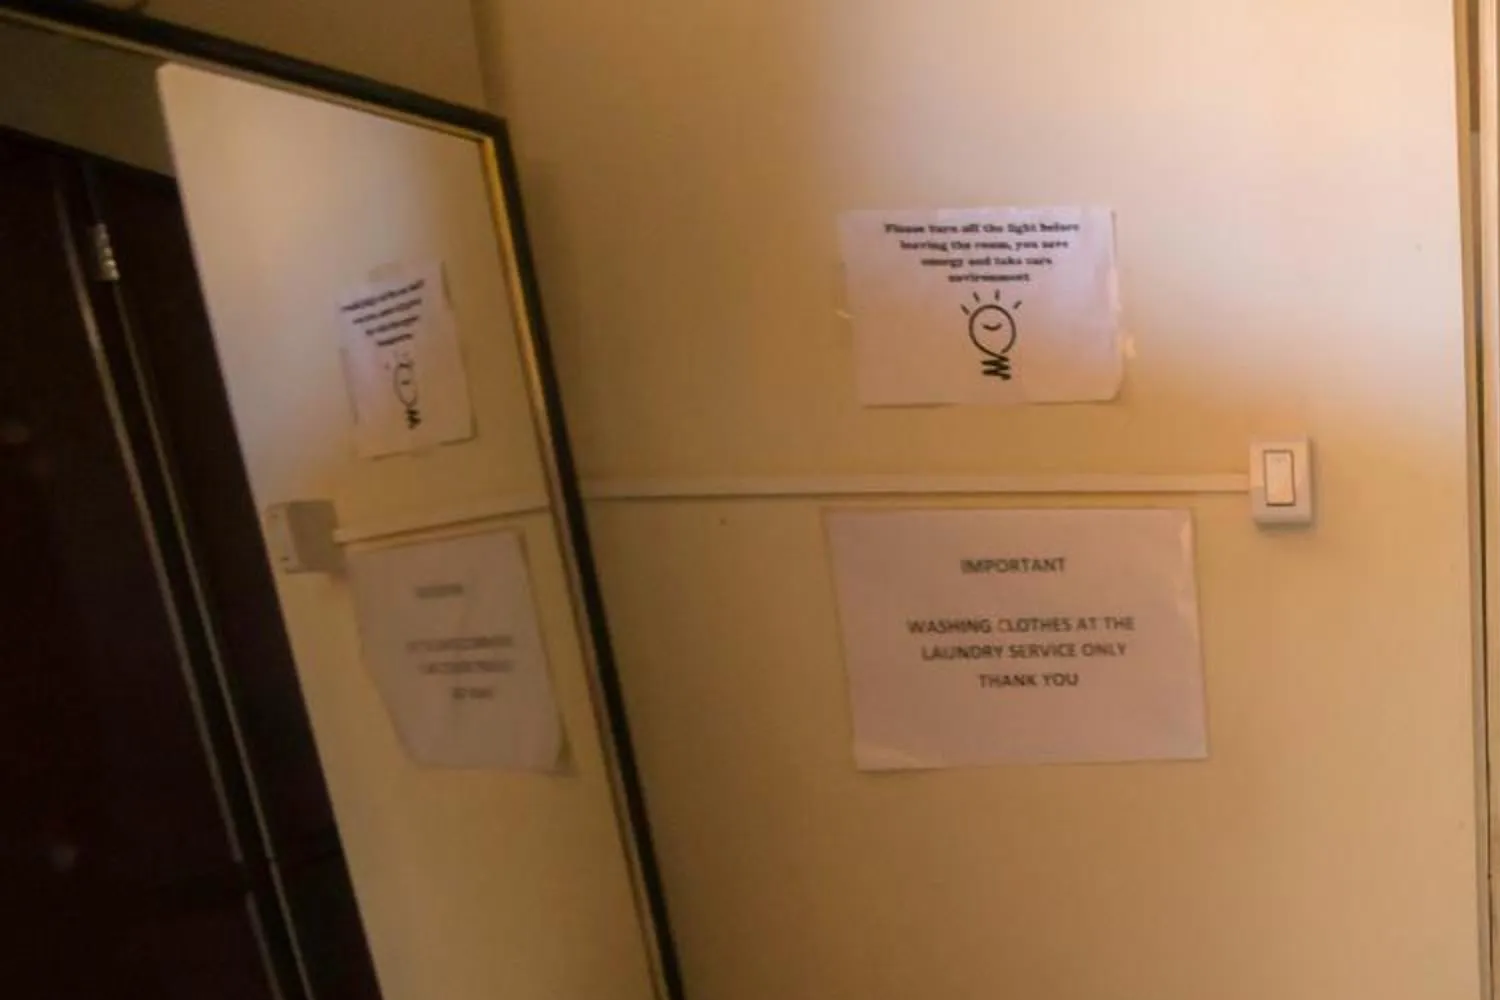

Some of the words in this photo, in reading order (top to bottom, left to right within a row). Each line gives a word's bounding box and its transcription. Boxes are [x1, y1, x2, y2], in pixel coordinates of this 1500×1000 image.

[960, 557, 1066, 574] IMPORTANT
[906, 617, 993, 634] WASHING
[997, 616, 1072, 633] CLOTHES
[1076, 616, 1098, 631] AT
[1103, 615, 1135, 631] THE
[921, 643, 1004, 661] LAUNDRY
[1008, 643, 1076, 659] SERVICE
[1081, 642, 1128, 657] ONLY
[979, 673, 1038, 688] THANK
[1042, 672, 1079, 687] YOU
